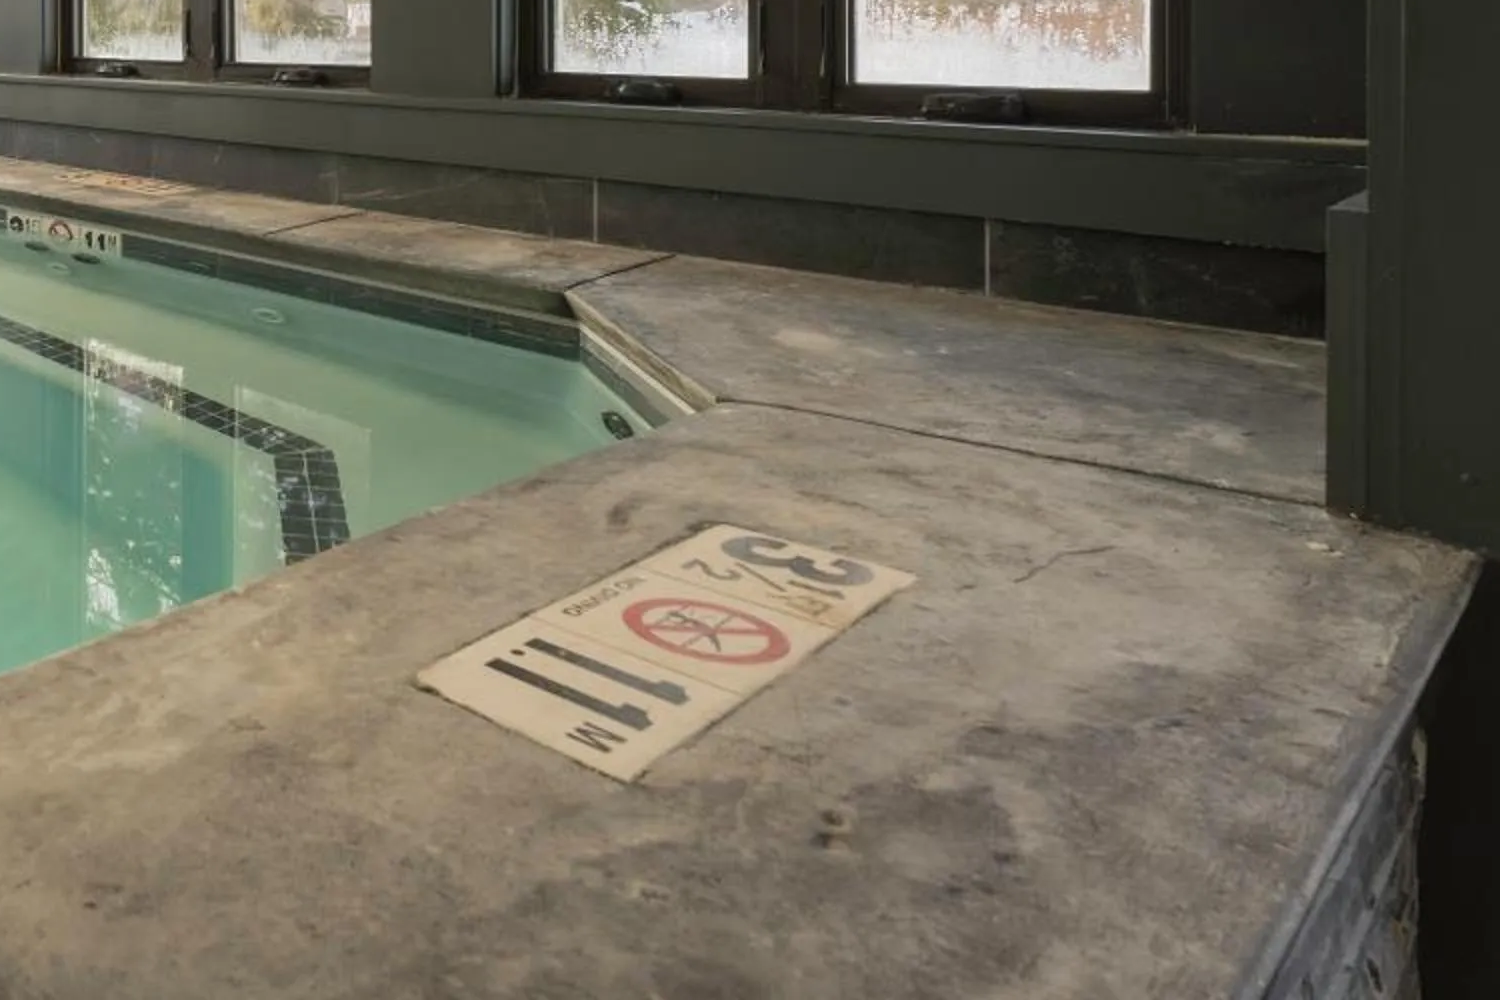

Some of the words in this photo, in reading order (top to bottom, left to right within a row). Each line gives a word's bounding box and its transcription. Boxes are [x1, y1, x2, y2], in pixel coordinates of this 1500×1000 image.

[721, 536, 875, 586] 3
[484, 637, 691, 732] 1.1
[566, 721, 628, 753] M
